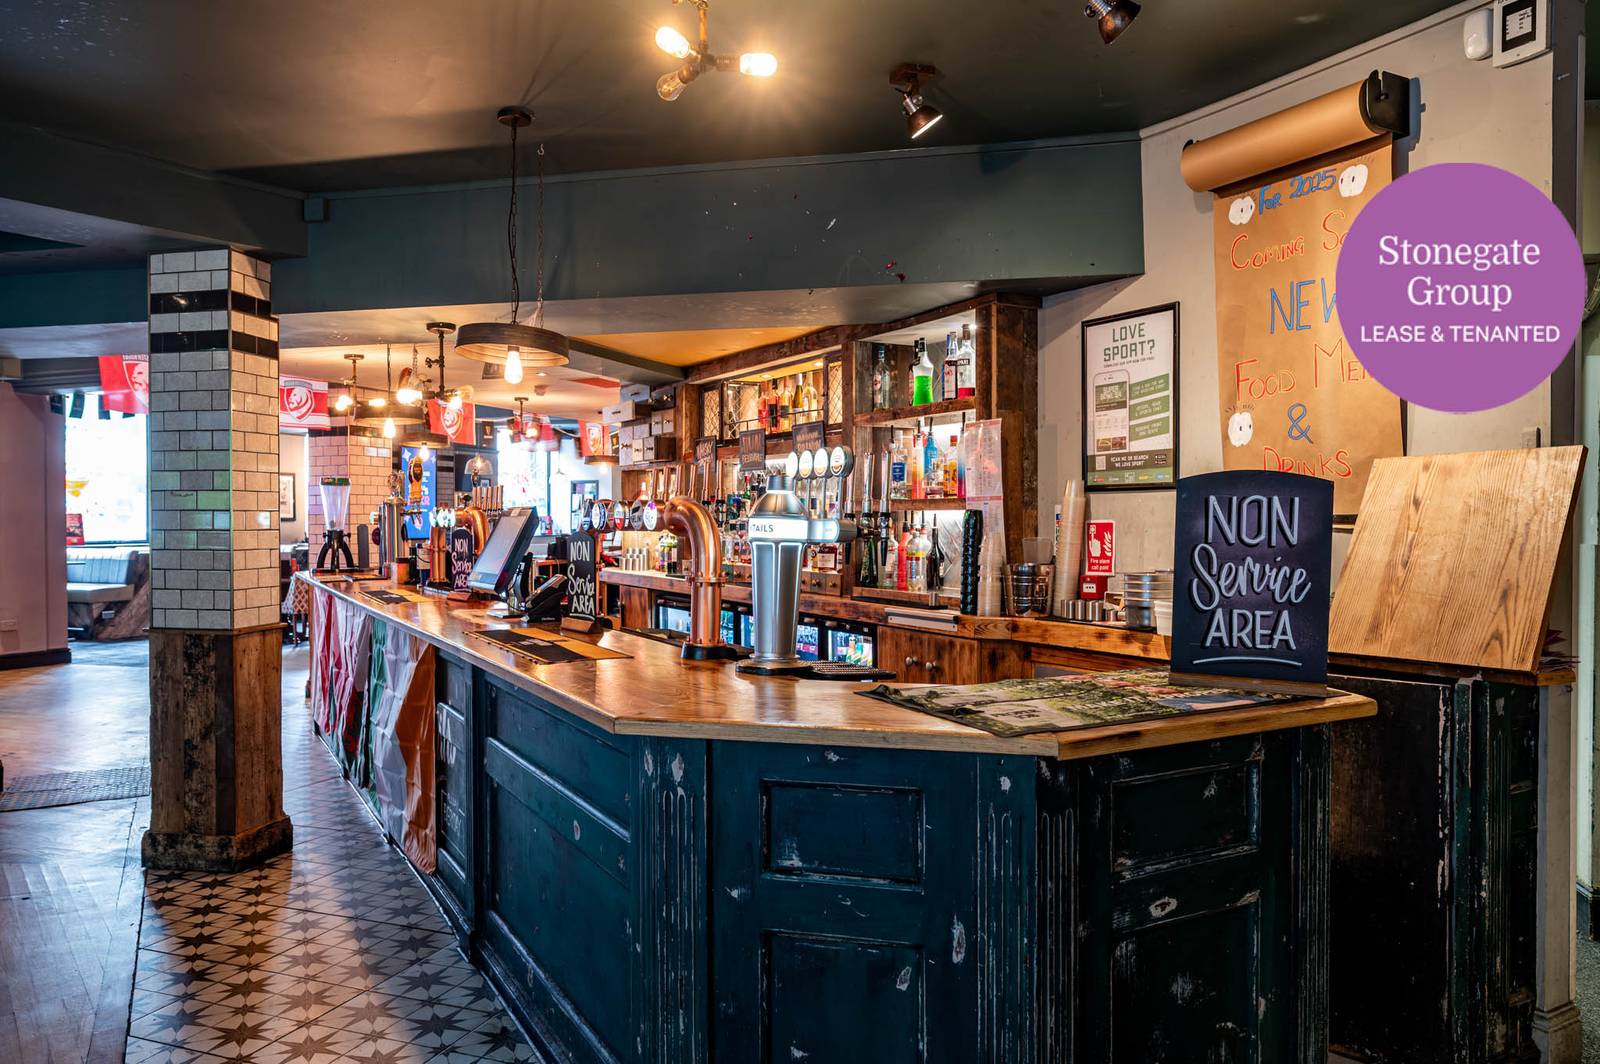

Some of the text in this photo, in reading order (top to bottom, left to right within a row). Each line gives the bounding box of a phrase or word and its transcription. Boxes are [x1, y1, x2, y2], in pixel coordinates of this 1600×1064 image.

[1290, 168, 1337, 198] 2025
[1112, 322, 1146, 342] LOVE
[1103, 339, 1155, 362] SPORT?
[1287, 402, 1313, 444] &
[1207, 495, 1300, 547] NON
[454, 538, 469, 553] NON
[570, 540, 590, 562] NON
[454, 574, 468, 588] ARE
[567, 563, 595, 596] Service
[1192, 543, 1312, 611] Service
[572, 595, 595, 616] AREA
[1204, 608, 1297, 650] AREA
